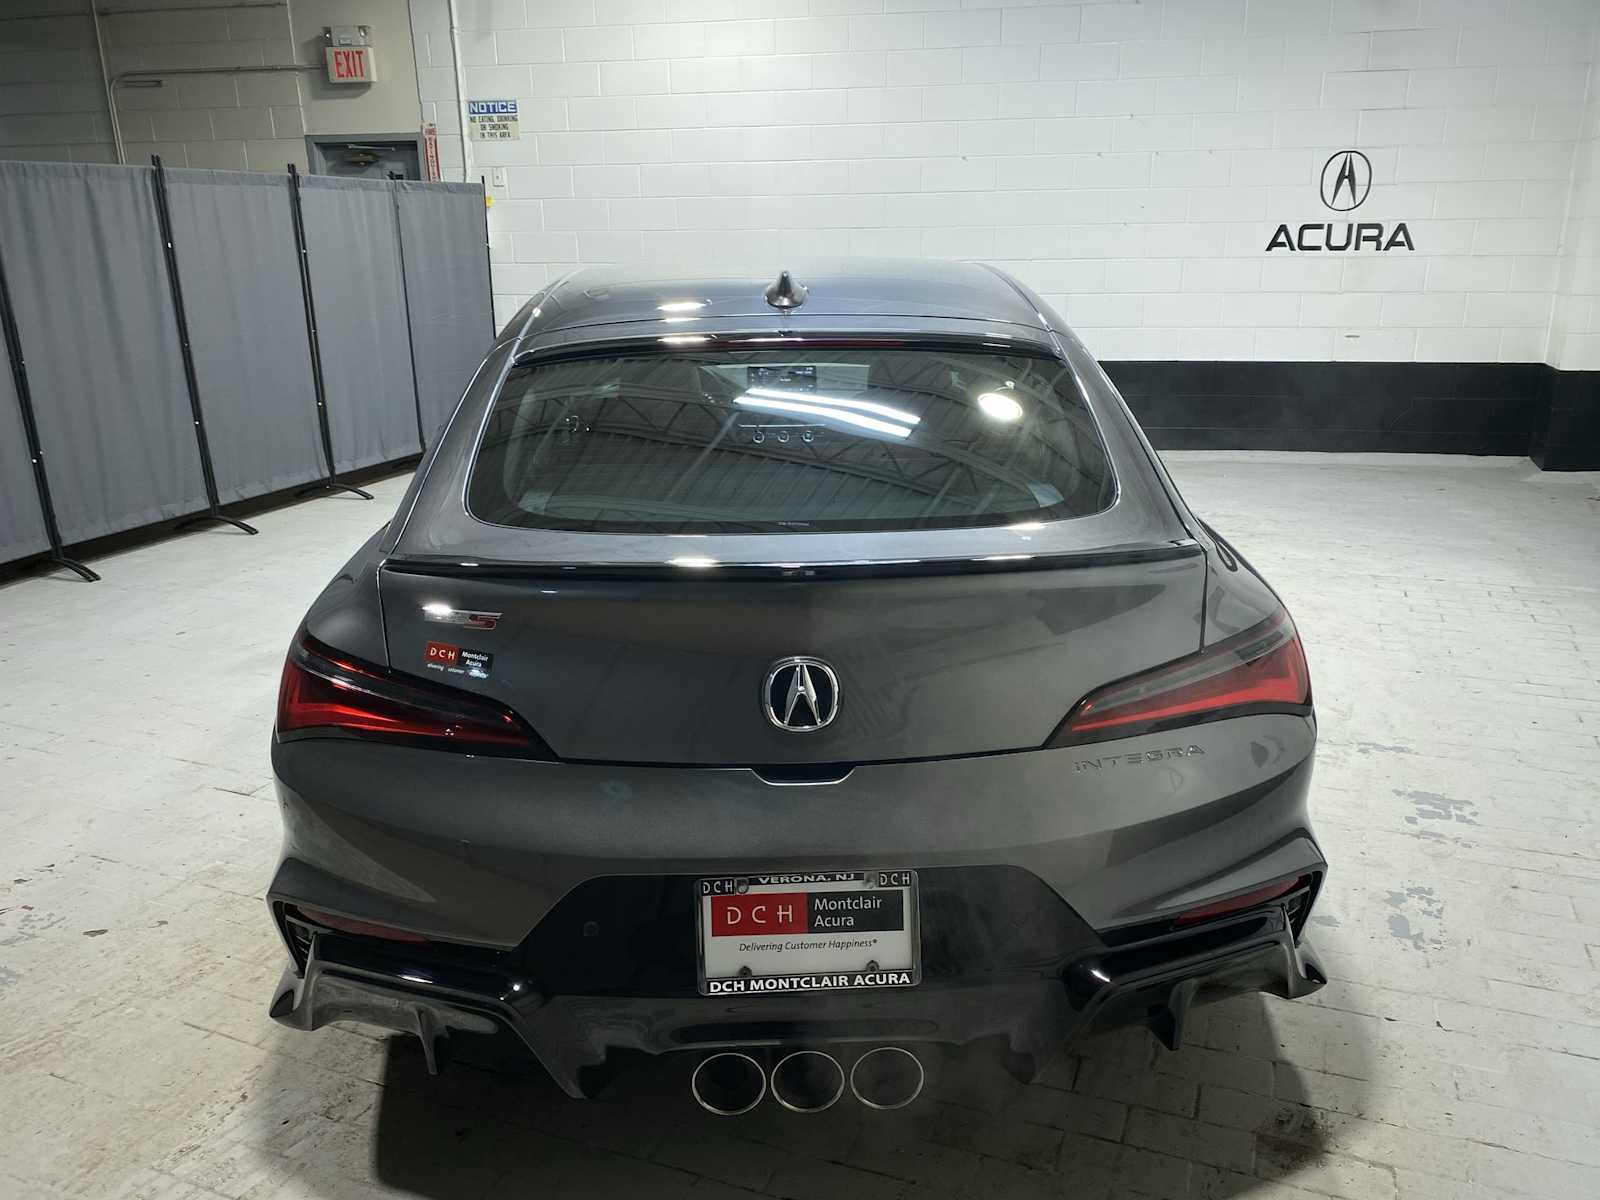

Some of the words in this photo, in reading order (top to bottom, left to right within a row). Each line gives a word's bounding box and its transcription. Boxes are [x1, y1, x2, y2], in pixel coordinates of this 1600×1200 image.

[334, 50, 364, 78] EXIT
[470, 102, 516, 113] NOTICE
[1265, 223, 1415, 251] ACURA
[461, 651, 489, 662] Montclair
[465, 660, 482, 668] Acura
[1073, 744, 1205, 772] INTEGRA
[835, 873, 855, 881] NJ
[814, 896, 882, 911] Montclair
[814, 915, 855, 927] Acura
[739, 942, 783, 952] Delivering
[785, 940, 827, 950] Customer
[710, 981, 745, 993] DCH
[749, 975, 850, 990] MONTCLAIR
[853, 972, 911, 986] ACURA
